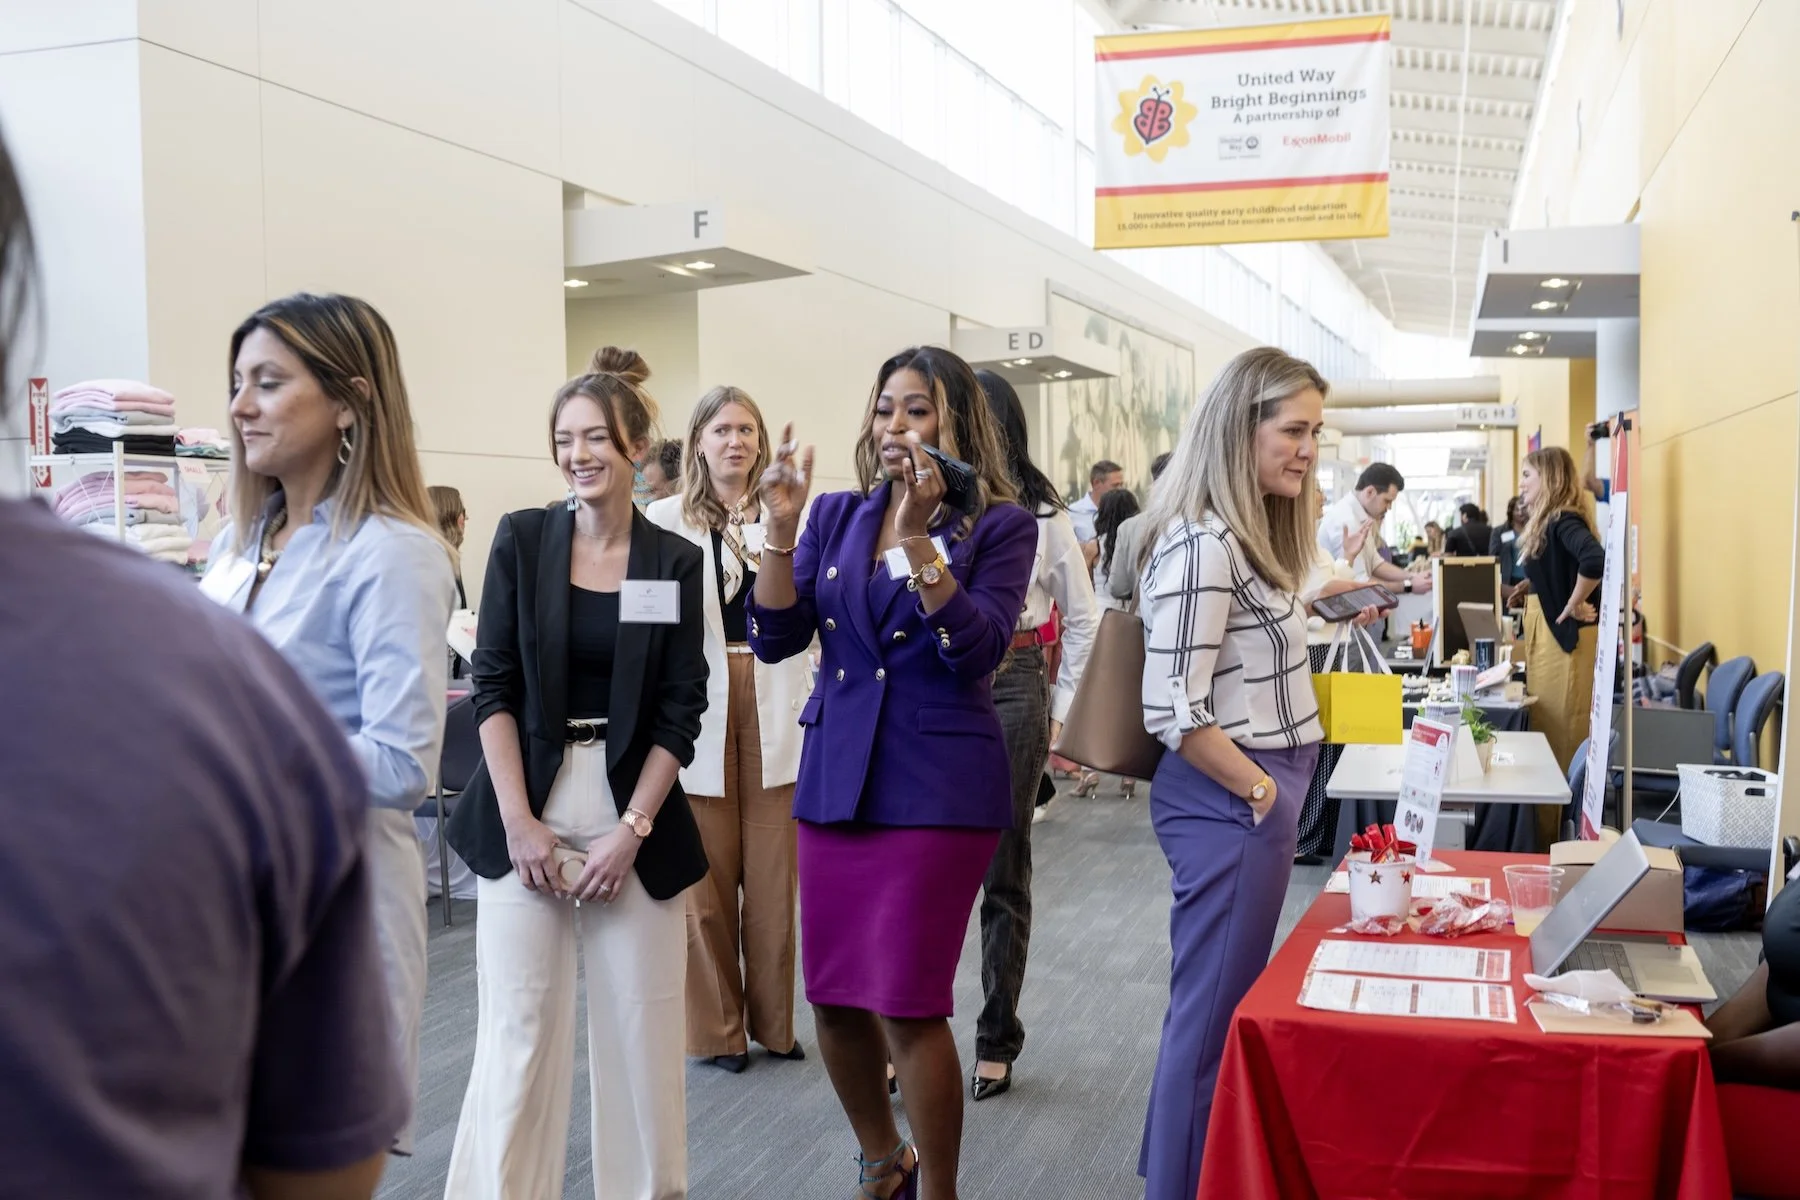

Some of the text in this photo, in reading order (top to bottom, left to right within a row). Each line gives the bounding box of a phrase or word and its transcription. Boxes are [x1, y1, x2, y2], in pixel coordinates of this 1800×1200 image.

[1237, 68, 1335, 87] United Way
[1211, 88, 1367, 110] Bright Beginnings
[1233, 106, 1340, 125] A partnership of
[1133, 203, 1347, 221] Innovative quality early childhood education
[1150, 221, 1185, 229] children
[1188, 218, 1225, 228] prepared
[1227, 218, 1240, 226] for
[1287, 214, 1316, 223] school
[694, 210, 708, 238] F
[1009, 332, 1043, 350] E D
